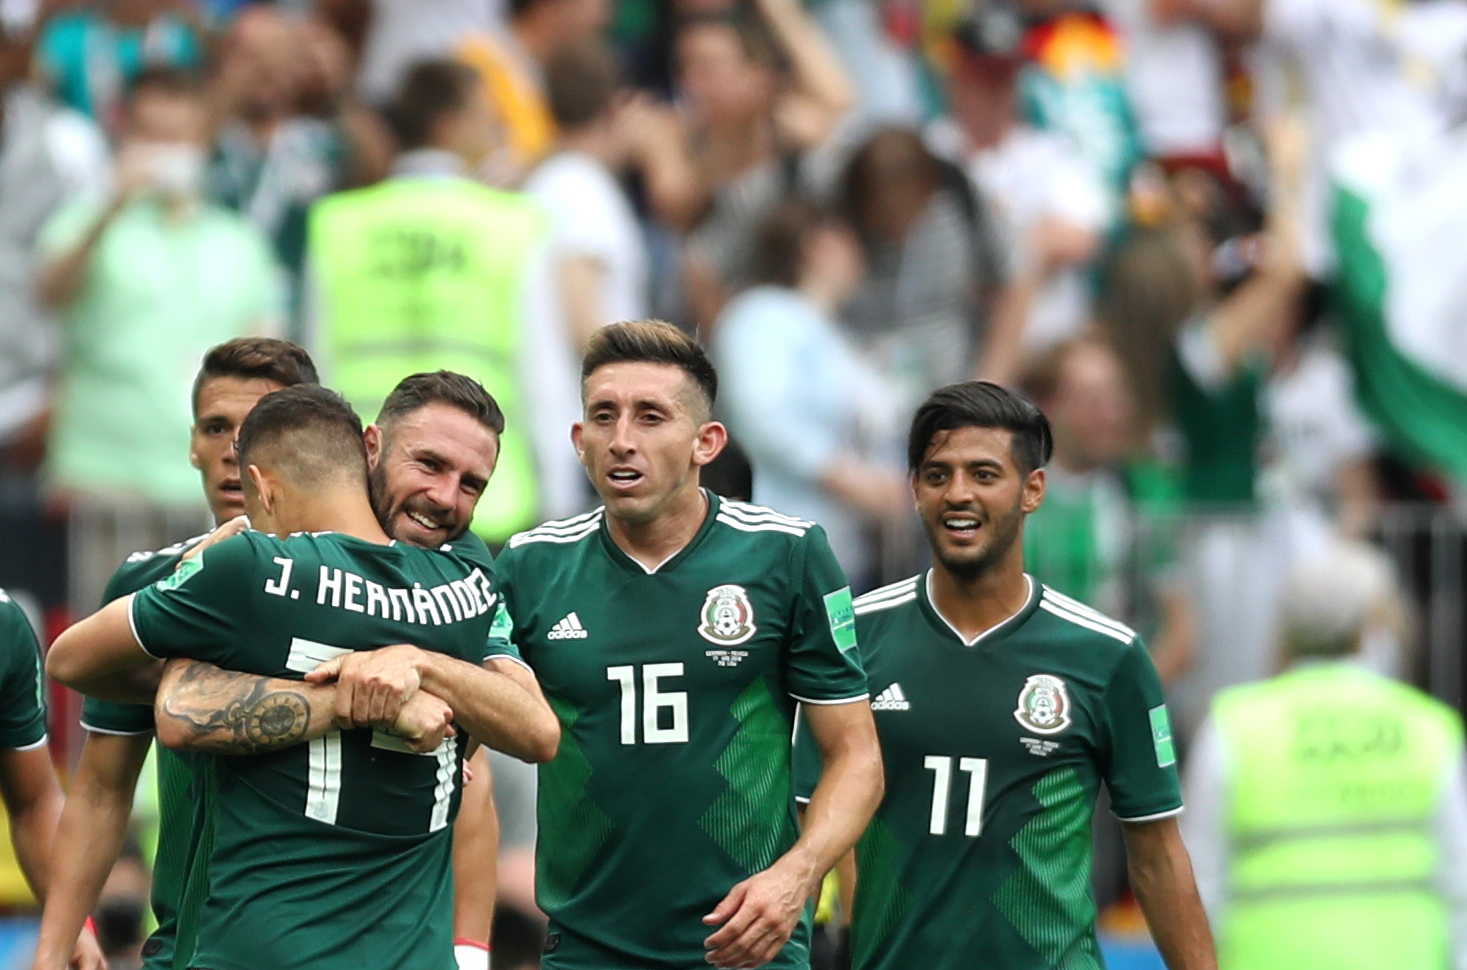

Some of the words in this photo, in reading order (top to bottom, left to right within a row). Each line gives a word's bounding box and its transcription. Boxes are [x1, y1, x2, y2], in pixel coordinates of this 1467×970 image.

[265, 556, 300, 600] J.
[547, 629, 589, 641] adidas
[607, 662, 689, 745] 16
[924, 755, 988, 837] 11
